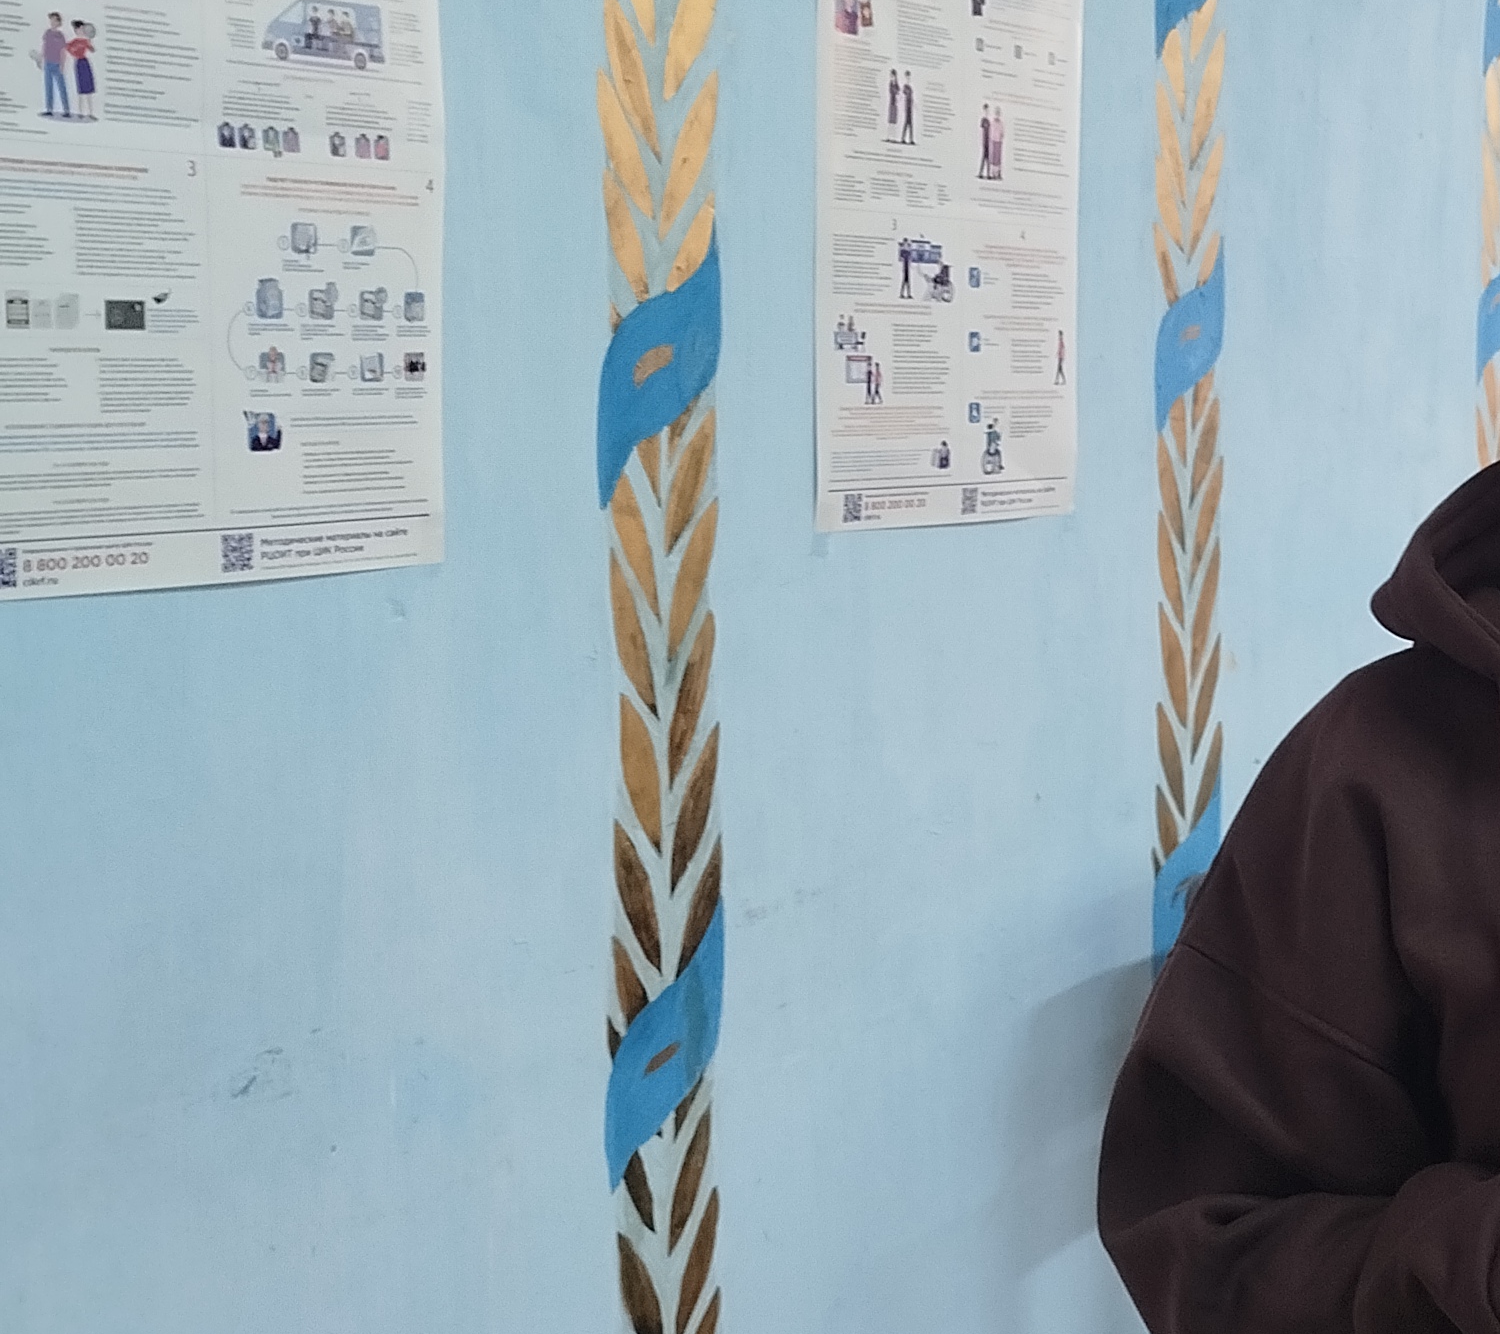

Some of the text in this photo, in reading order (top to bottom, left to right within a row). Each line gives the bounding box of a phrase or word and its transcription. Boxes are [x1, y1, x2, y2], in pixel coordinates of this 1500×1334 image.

[186, 160, 198, 177] 3
[425, 179, 435, 194] 4
[23, 551, 150, 573] 8 800 200 00 20
